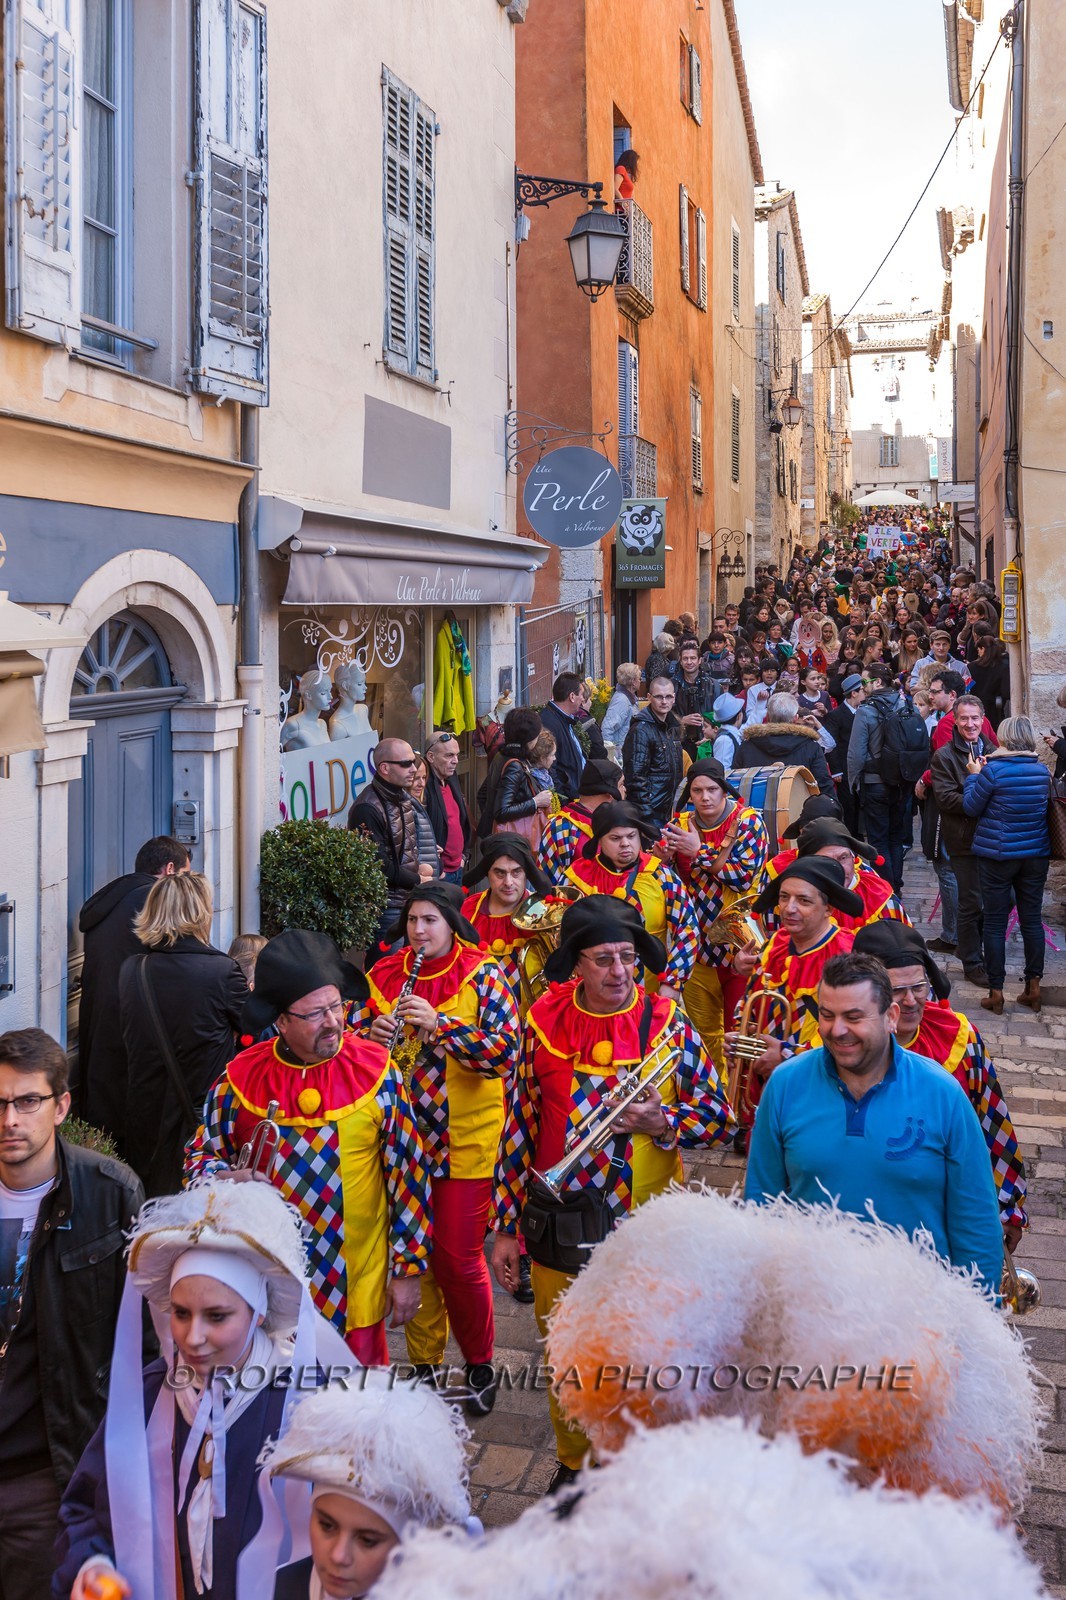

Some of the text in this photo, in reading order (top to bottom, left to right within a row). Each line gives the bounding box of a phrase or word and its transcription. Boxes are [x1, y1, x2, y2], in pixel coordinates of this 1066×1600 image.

[535, 465, 552, 473] Une
[529, 468, 612, 511] Perle
[564, 520, 606, 532] à Valbonne
[874, 527, 892, 535] ILE
[871, 538, 899, 547] VERTE
[618, 563, 664, 571] 365 FROMAGES
[634, 575, 659, 583] GAYRAUD
[396, 575, 416, 600] Une
[419, 567, 441, 600] Perle
[450, 568, 482, 600] Valbonne
